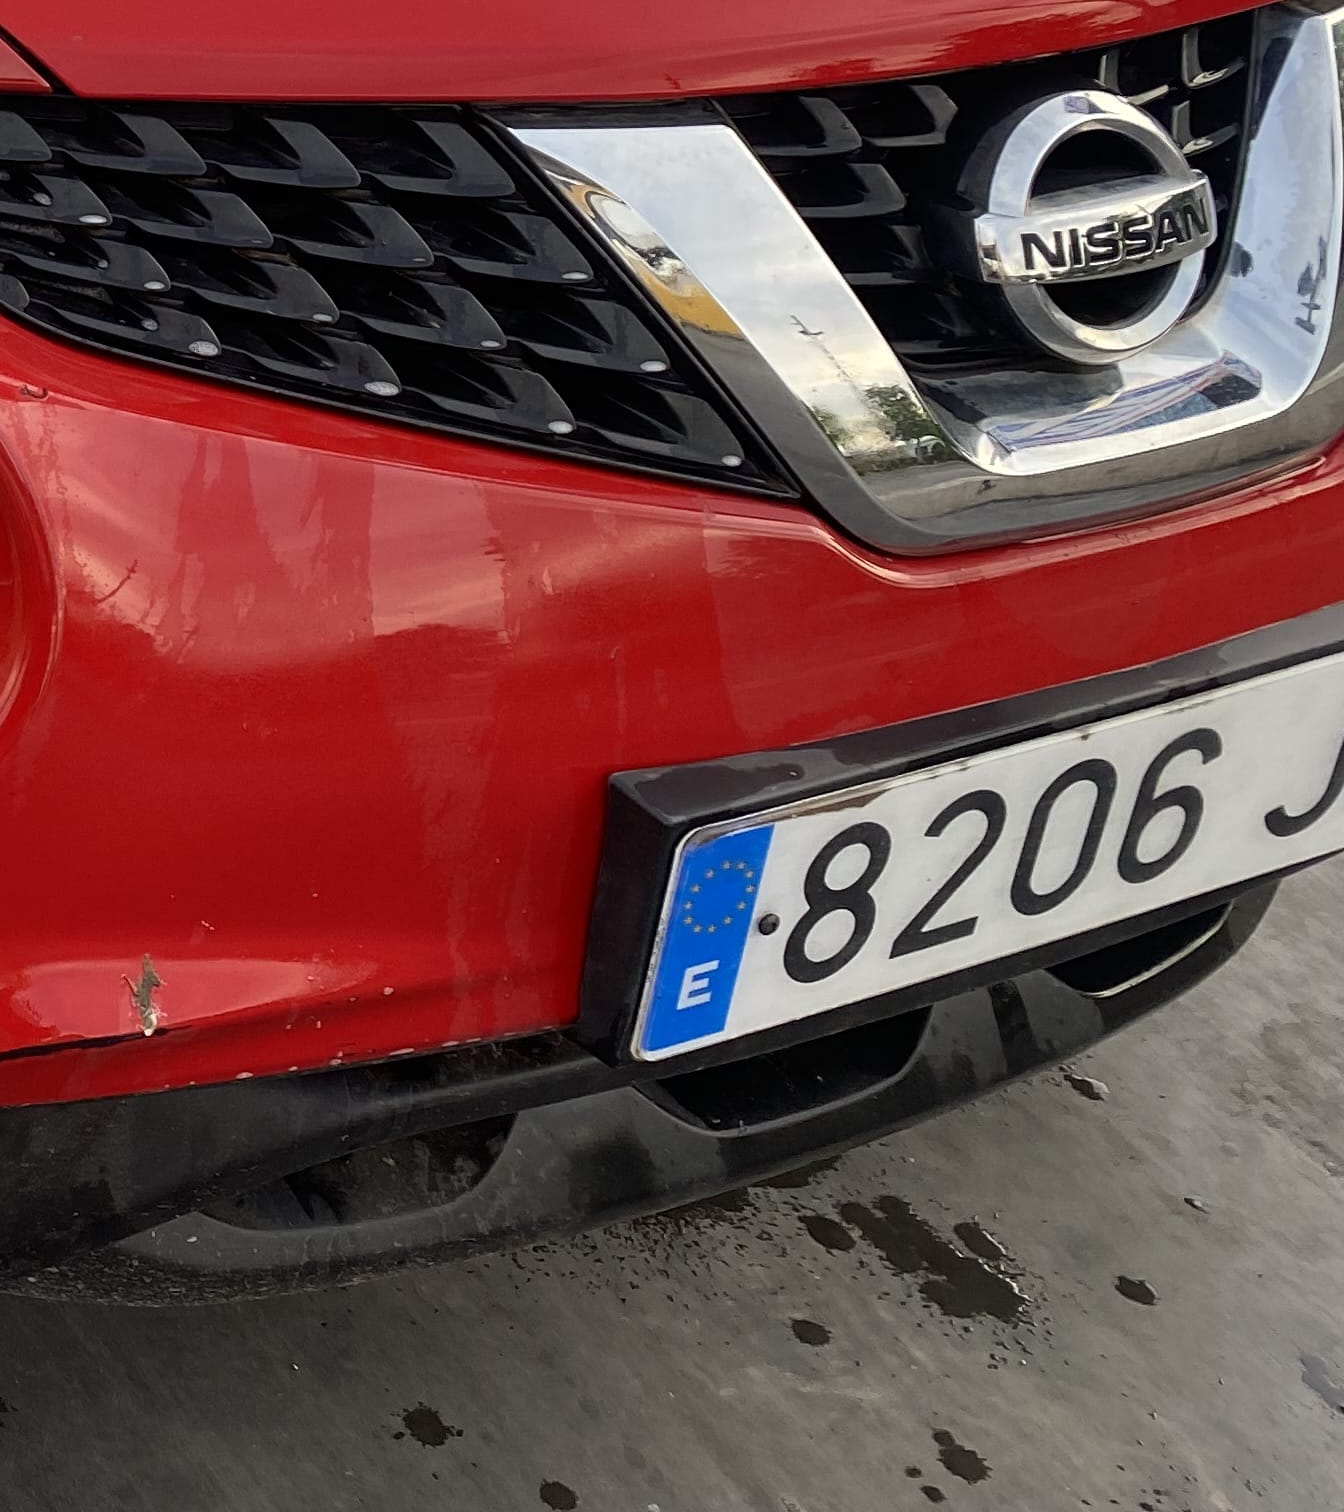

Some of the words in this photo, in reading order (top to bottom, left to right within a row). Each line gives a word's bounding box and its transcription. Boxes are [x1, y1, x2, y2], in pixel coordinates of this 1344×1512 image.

[1019, 195, 1211, 272] NISSAN
[783, 727, 1223, 984] 8206
[676, 959, 723, 1012] E
